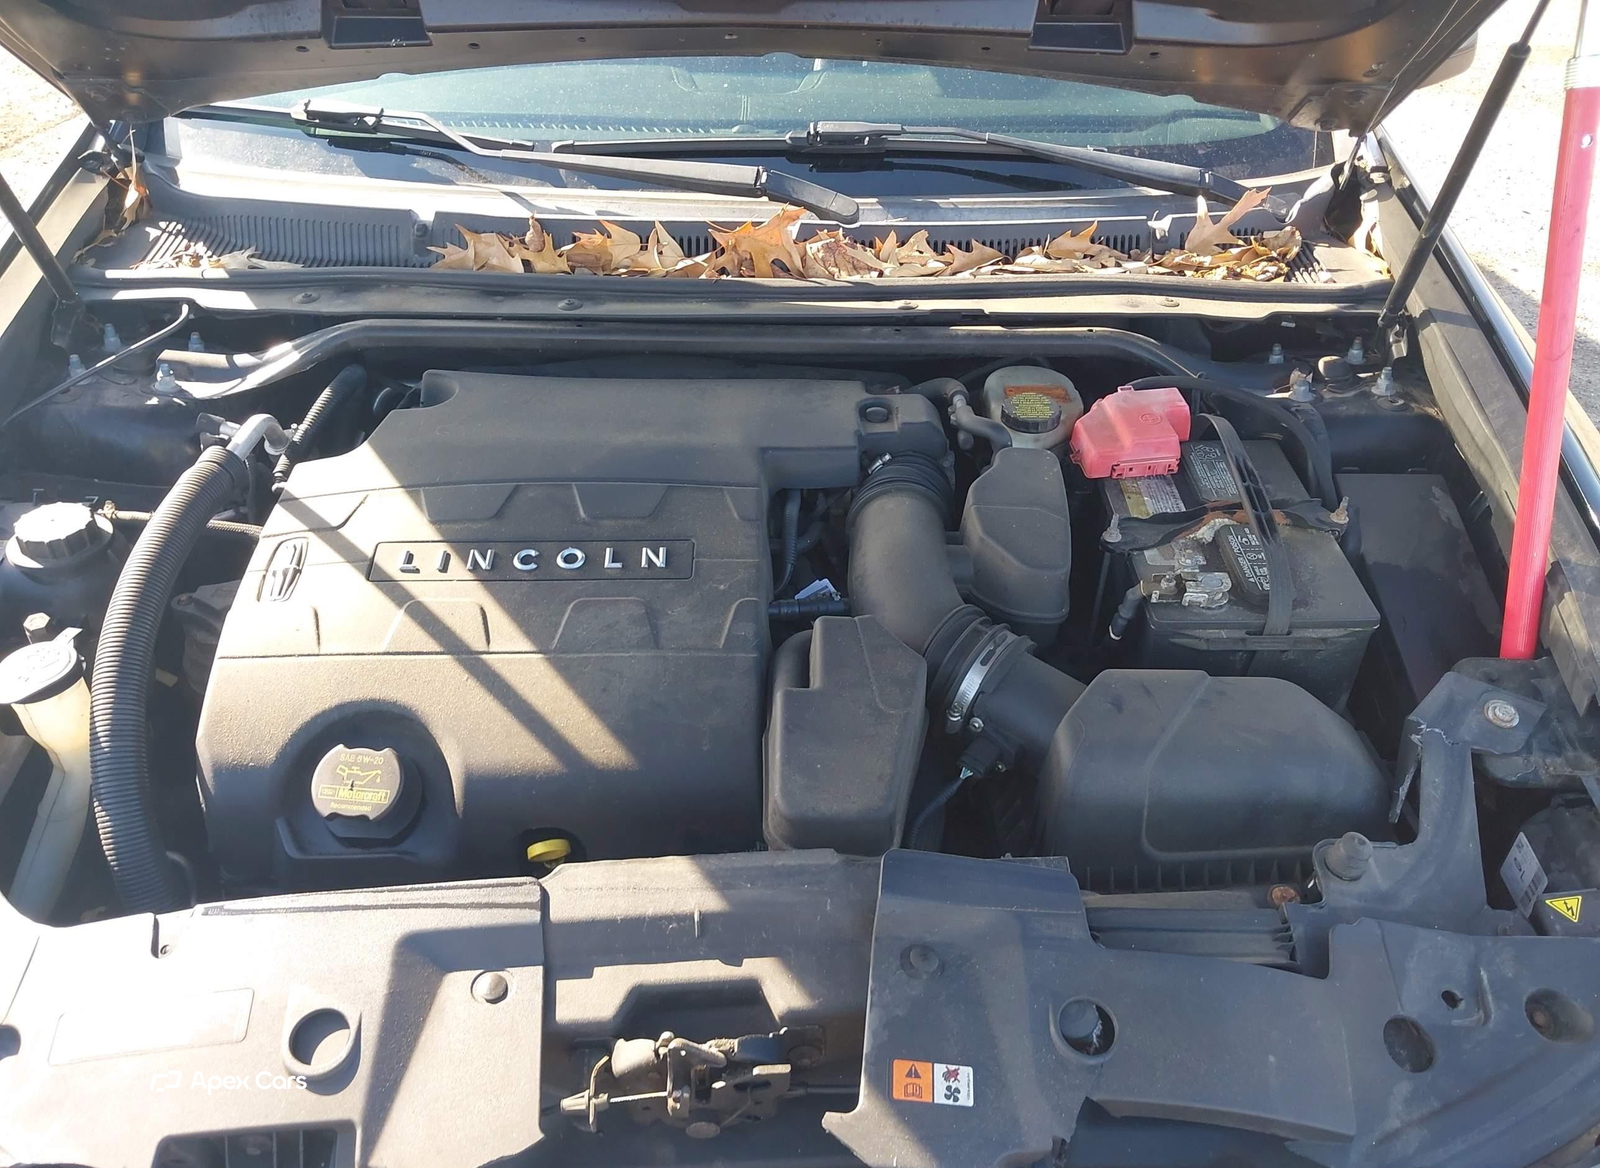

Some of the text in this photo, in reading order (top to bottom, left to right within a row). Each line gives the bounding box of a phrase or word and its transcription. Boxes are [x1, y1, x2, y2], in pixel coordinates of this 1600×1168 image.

[399, 546, 668, 572] LINCOLN
[339, 754, 384, 765] SAE 5W-20
[337, 787, 387, 802] Motorcraft
[330, 801, 373, 812] Recommended
